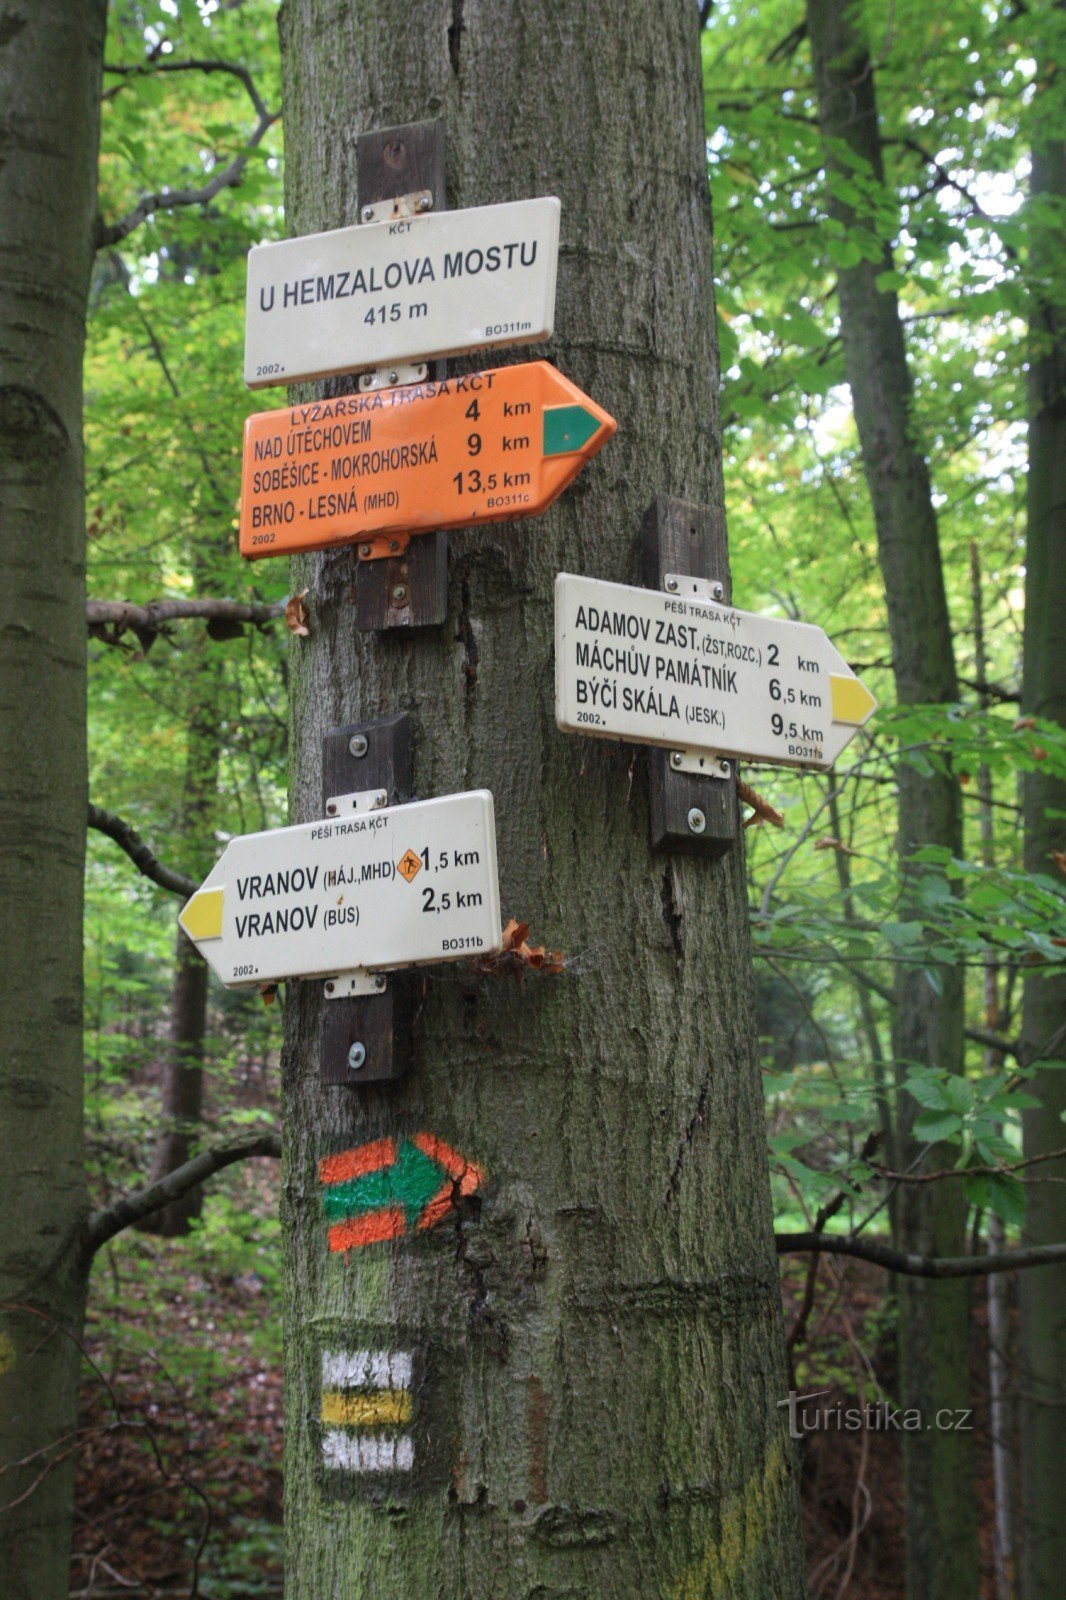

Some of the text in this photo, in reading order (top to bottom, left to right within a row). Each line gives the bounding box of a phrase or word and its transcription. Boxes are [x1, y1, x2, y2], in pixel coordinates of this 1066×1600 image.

[389, 222, 412, 235] KČT
[260, 240, 538, 312] U HEMZALOVA MOSTU
[364, 302, 428, 326] 415 m
[389, 382, 450, 405] TRASA
[456, 373, 496, 394] KČT
[254, 399, 531, 462] NAD ÚTĚCHOVEM 4 km
[253, 461, 320, 494] SOBĚŠICE
[331, 434, 439, 482] MOKROHORSKÁ
[467, 433, 482, 457] 9
[502, 436, 530, 452] km
[252, 500, 295, 529] BRNO
[308, 485, 358, 521] LESNÁ
[363, 490, 400, 515] (MHD)
[452, 469, 498, 495] 13,5
[503, 472, 531, 488] km
[252, 533, 276, 546] 2002
[575, 605, 651, 642] ADAMOV
[655, 620, 701, 652] ZAST.
[767, 643, 781, 668] 2
[798, 655, 821, 675] km
[664, 601, 742, 627] PĚŠÍ TRASA KČT
[576, 639, 823, 709] MÁCHŮV PAMÁTNÍK 6,5 km
[576, 676, 825, 743] BÝČÍ SKÁLA (JESK.) 9,5 km
[311, 816, 389, 841] PĚŠÍ TRASA KČT
[236, 865, 319, 901] VRANOV
[420, 846, 449, 873] 1,5
[454, 850, 480, 867] km
[235, 886, 483, 939] VRANOV (BUS) 2,5 km
[442, 936, 484, 951] BO311b
